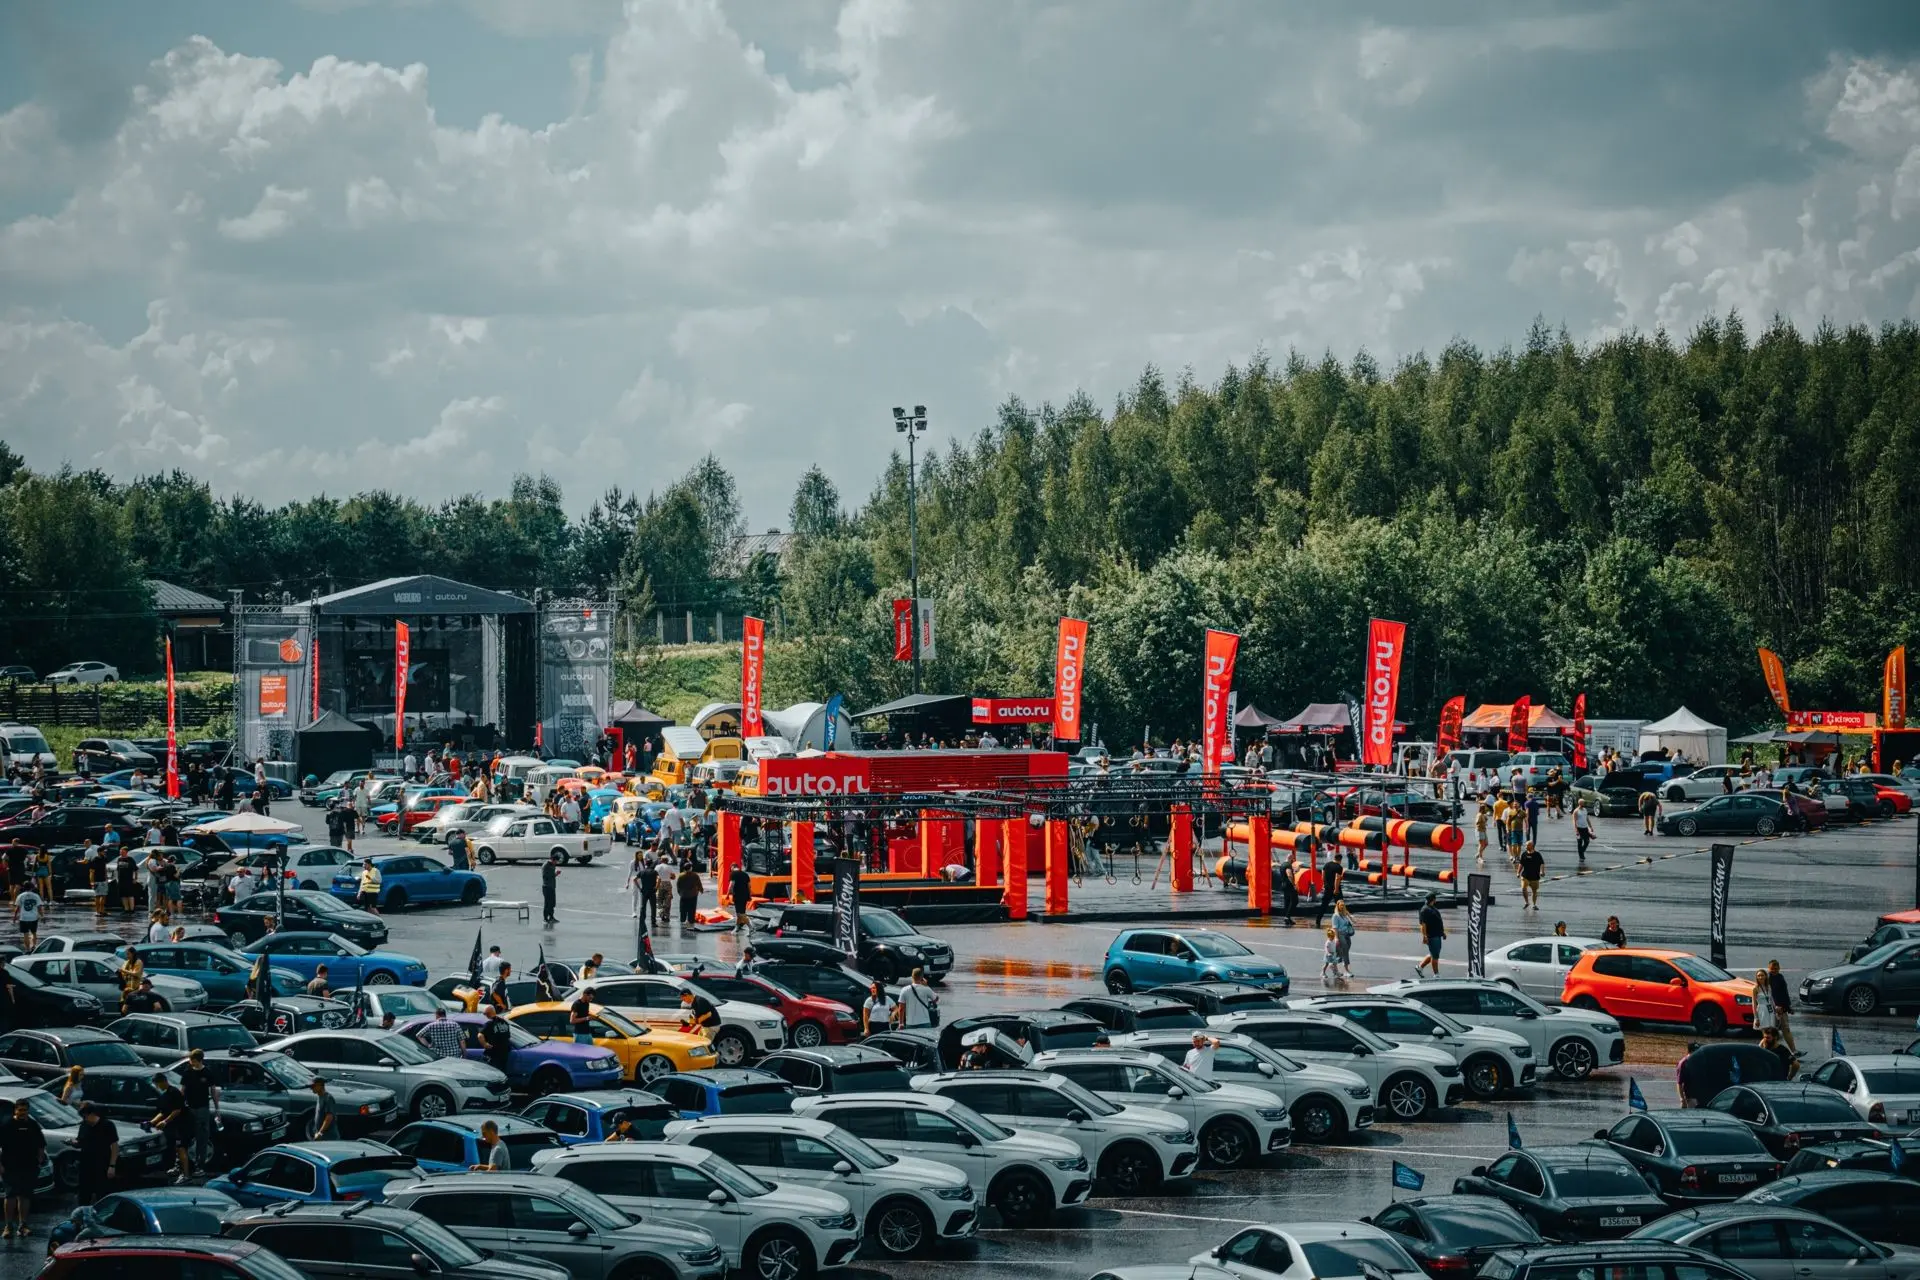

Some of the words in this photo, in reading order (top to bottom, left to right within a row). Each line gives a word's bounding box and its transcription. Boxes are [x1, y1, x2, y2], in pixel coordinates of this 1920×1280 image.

[746, 636, 760, 723] auto.ru
[998, 705, 1049, 717] auto.ru
[1061, 636, 1078, 722] auto.ru
[1371, 641, 1394, 744] auto.ru
[767, 773, 870, 796] auto.ru
[836, 873, 858, 959] Eventism
[1712, 858, 1725, 944] Eventism
